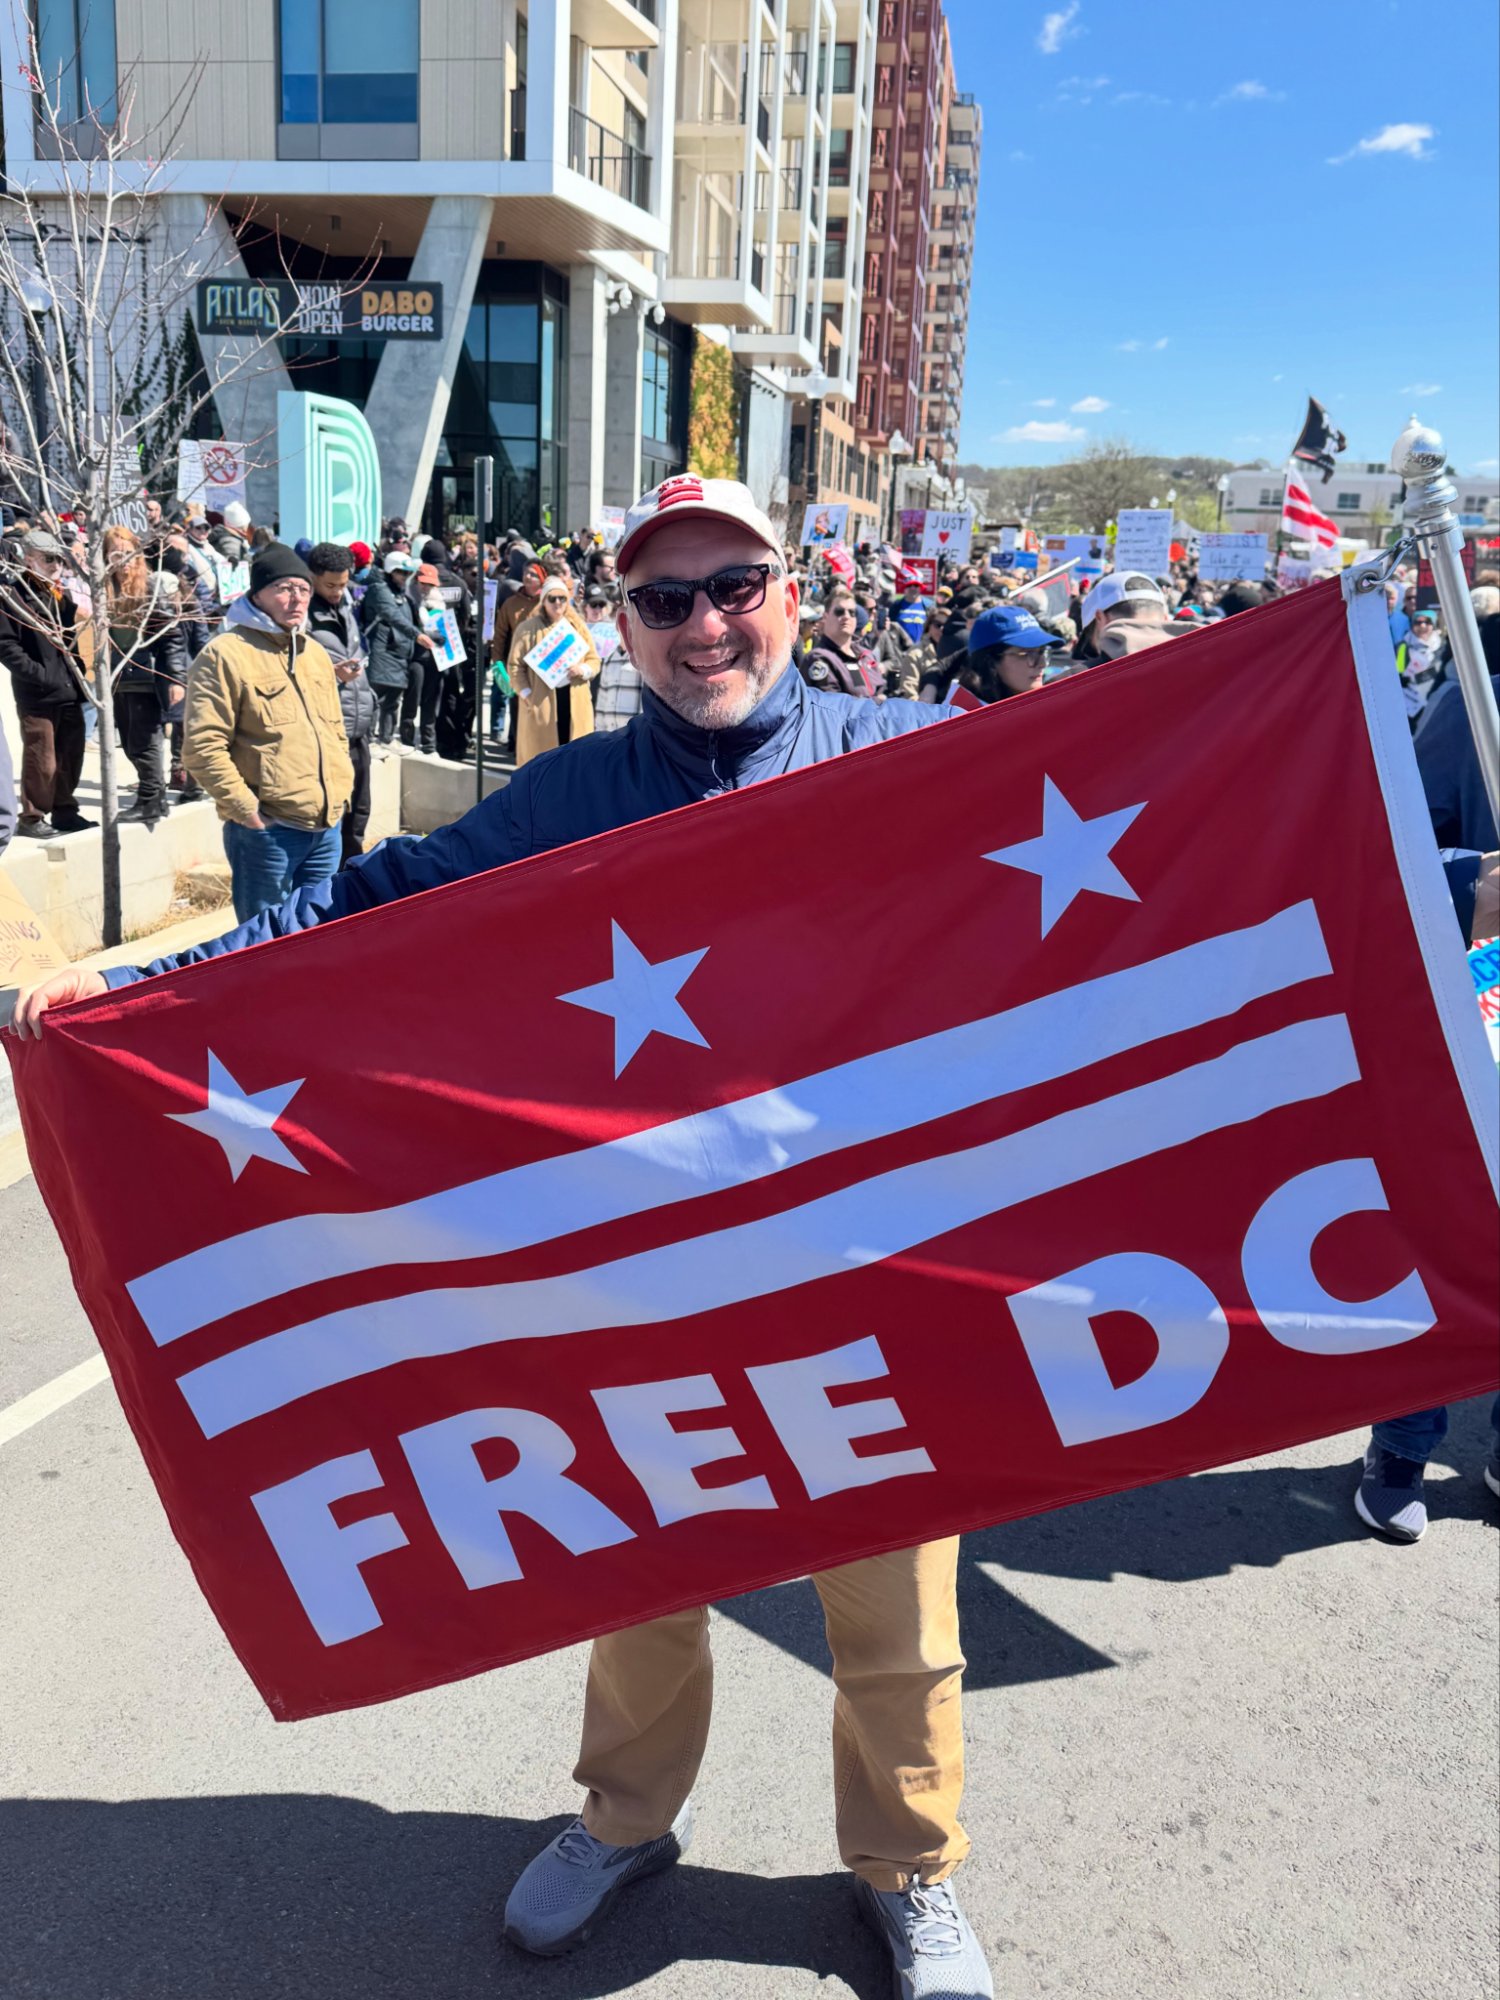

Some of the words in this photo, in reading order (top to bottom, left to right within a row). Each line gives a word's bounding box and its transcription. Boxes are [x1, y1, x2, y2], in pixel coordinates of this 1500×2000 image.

[206, 285, 280, 328] ATLAS
[299, 285, 342, 310] NOW
[362, 290, 433, 315] DABO
[299, 310, 343, 335] OPEN
[361, 315, 434, 332] BURGER
[112, 500, 148, 534] INGS
[931, 515, 966, 530] JUST
[1206, 534, 1260, 548] REIST
[251, 1335, 936, 1647] FREE
[1006, 1157, 1439, 1447] DC
